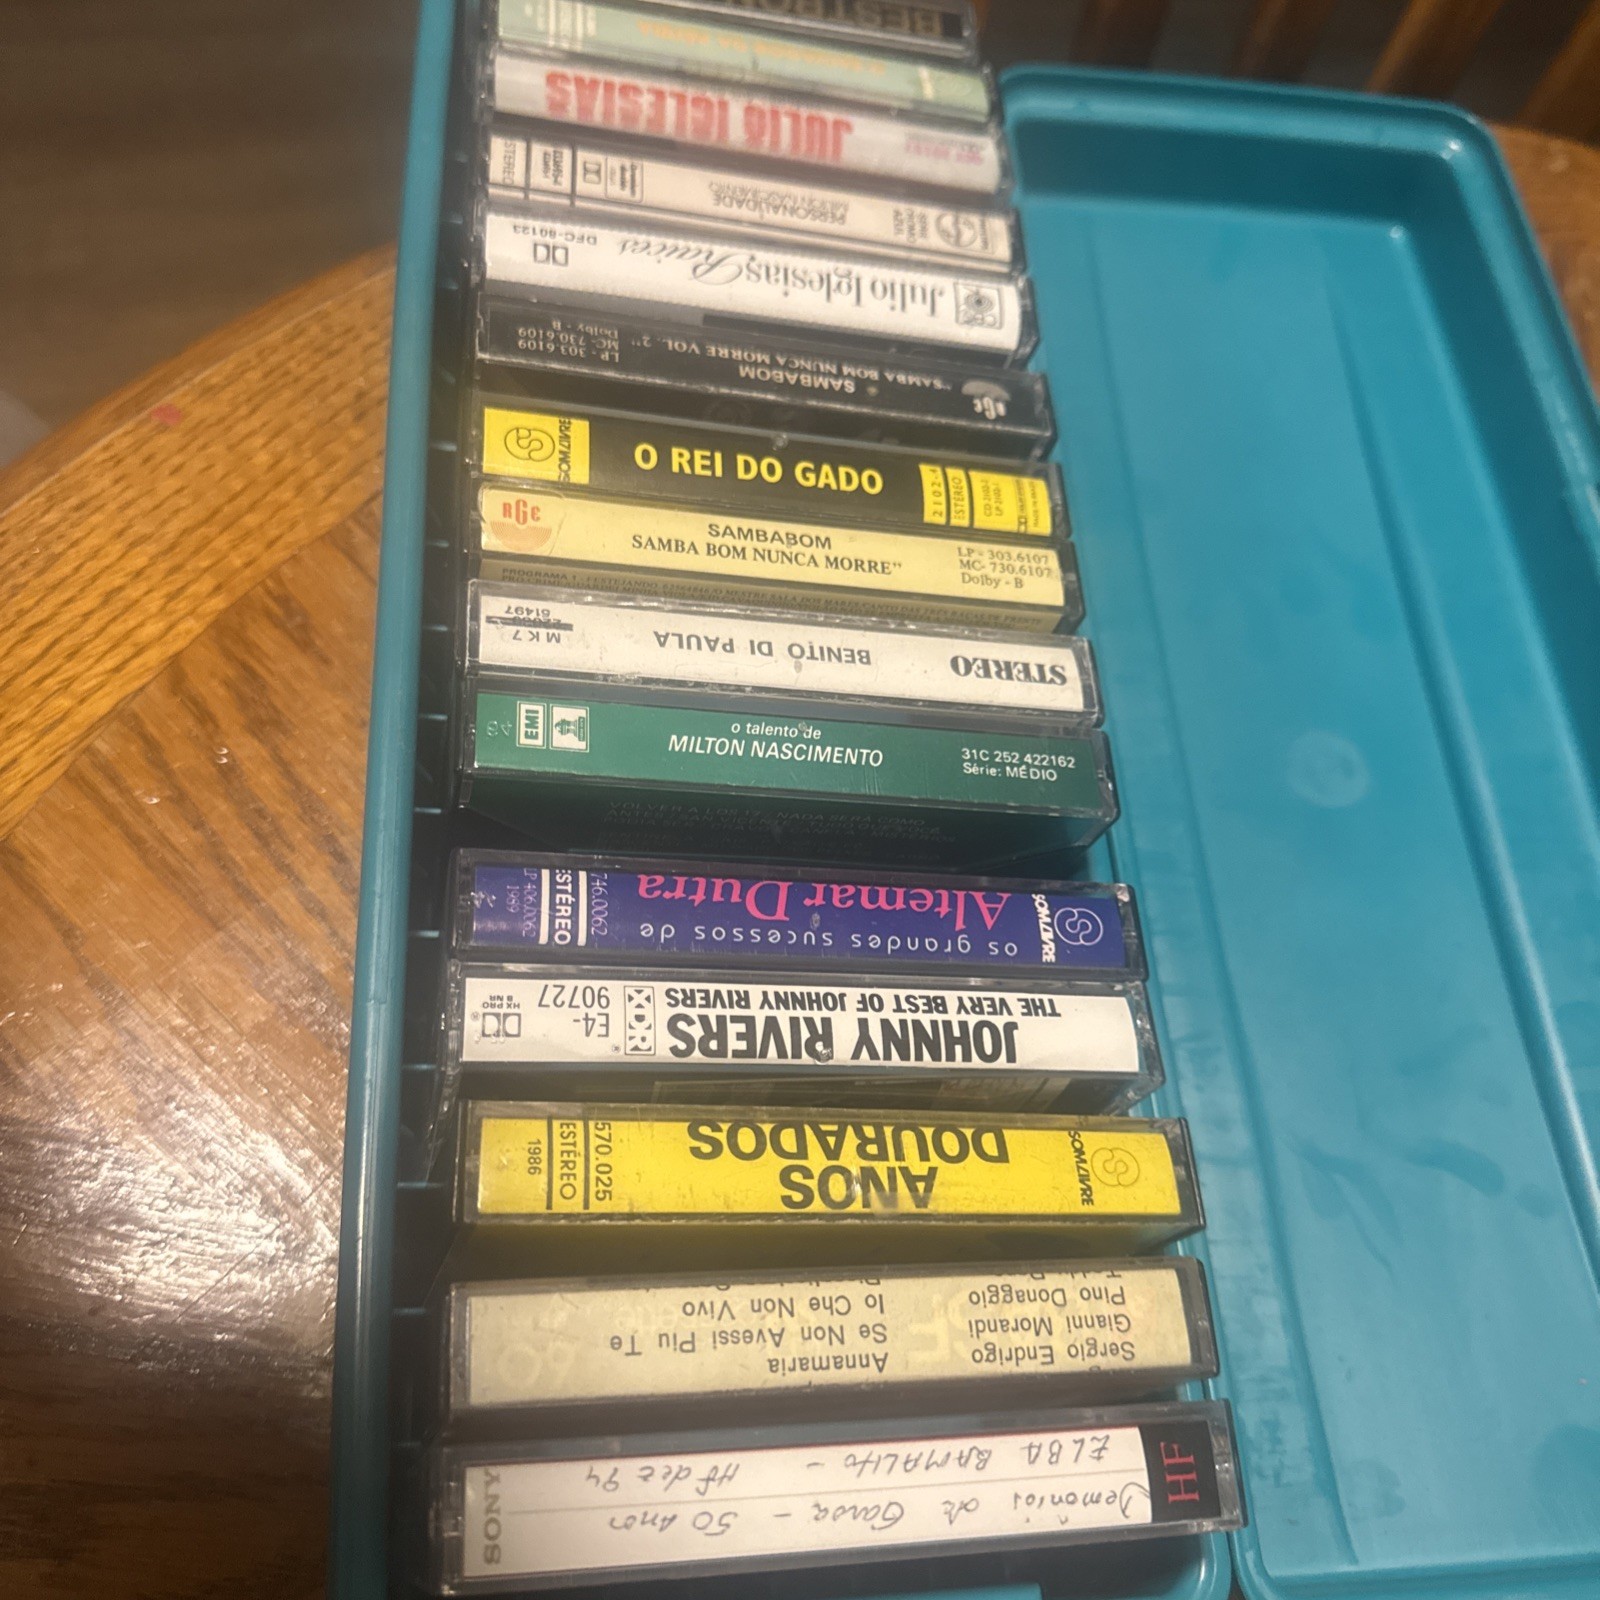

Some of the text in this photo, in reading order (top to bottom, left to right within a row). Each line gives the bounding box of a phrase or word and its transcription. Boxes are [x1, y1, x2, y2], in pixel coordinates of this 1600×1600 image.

[543, 71, 852, 166] JULIO IGLESIAS
[711, 194, 847, 225] PERSONALIDADE
[746, 256, 863, 306] Iglesias
[869, 273, 945, 318] Julio
[518, 328, 585, 346] 730.6109
[552, 320, 561, 330] B
[577, 324, 618, 339] Dolby
[518, 339, 586, 358] 303.6109
[600, 351, 619, 362] LP
[705, 344, 771, 366] MORRE
[738, 364, 856, 394] SAMBABOM
[775, 355, 837, 375] NUNCA
[841, 366, 879, 381] BOM
[634, 443, 884, 495] O REI DO GADO
[707, 522, 832, 550] SAMBABOM
[631, 535, 699, 556] SAMBA
[706, 541, 747, 561] BOM
[752, 544, 821, 569] NUNCA
[957, 547, 974, 557] LP
[988, 550, 1048, 565] 303.6107
[961, 573, 1001, 589] Dolby
[1014, 577, 1024, 588] B
[990, 562, 1052, 578] 730.6107
[654, 629, 872, 667] BENITO DI PAULA
[949, 653, 1068, 686] STEREO
[524, 709, 539, 740] EMI
[731, 718, 822, 741] o talento de
[666, 733, 883, 768] MILTON NASCIMENTO
[960, 746, 1077, 770] 31C 252 422162
[962, 760, 1058, 783] Série: MÉDIO
[506, 885, 520, 913] 1989
[636, 873, 1013, 931] Altemar Dutra
[638, 922, 1019, 958] os grandes sucessos de
[482, 1001, 504, 1009] PRO
[537, 984, 610, 1009] 90727
[664, 987, 1062, 1018] THE VERY BEST OF JOHNNY RIVERS
[572, 1012, 610, 1037] E4-
[666, 1012, 1020, 1065] JOHNNY RIVERS
[687, 1119, 1009, 1164] DOURADOS
[527, 1139, 542, 1175] 1986
[559, 1122, 581, 1200] ESTÉREO
[595, 1122, 613, 1201] 570.025
[779, 1163, 939, 1214] ANOS
[681, 1292, 886, 1321] Io Che Non Vivo
[967, 1284, 1126, 1310] Pino Donaggio
[608, 1320, 888, 1357] Se Non Avessi Piu Te
[967, 1312, 1132, 1338] Gianni Morandi
[764, 1350, 890, 1379] Annamaria
[970, 1336, 1136, 1365] Sergio Endrigo
[1018, 1434, 1110, 1464] ELBA
[584, 1465, 620, 1492] 94
[1159, 1440, 1201, 1504] HF
[482, 1465, 502, 1566] SONY
[691, 1509, 739, 1539] 50
